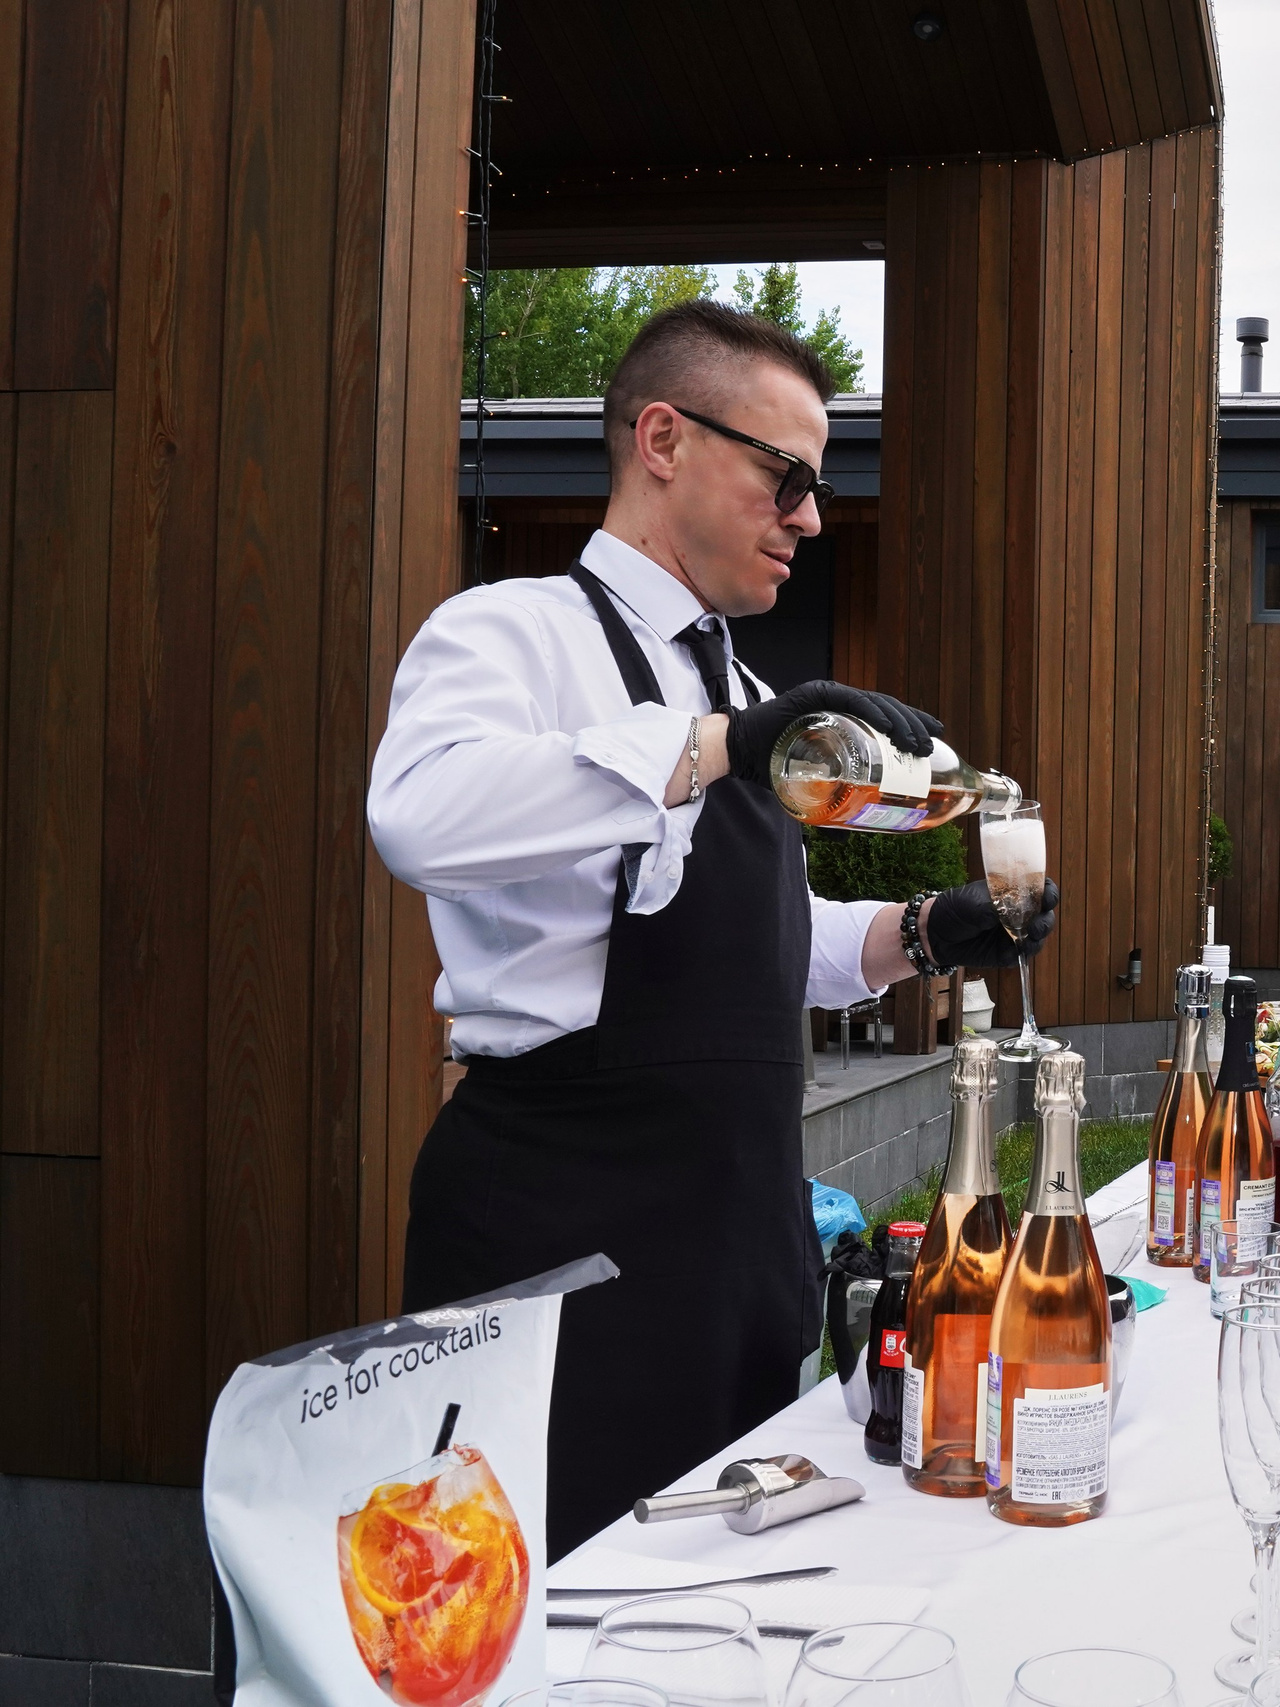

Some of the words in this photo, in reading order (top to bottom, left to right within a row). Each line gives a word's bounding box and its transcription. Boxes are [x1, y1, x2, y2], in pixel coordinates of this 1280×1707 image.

[301, 1384, 338, 1424] ice
[344, 1360, 382, 1400] for
[388, 1309, 502, 1378] cocktails
